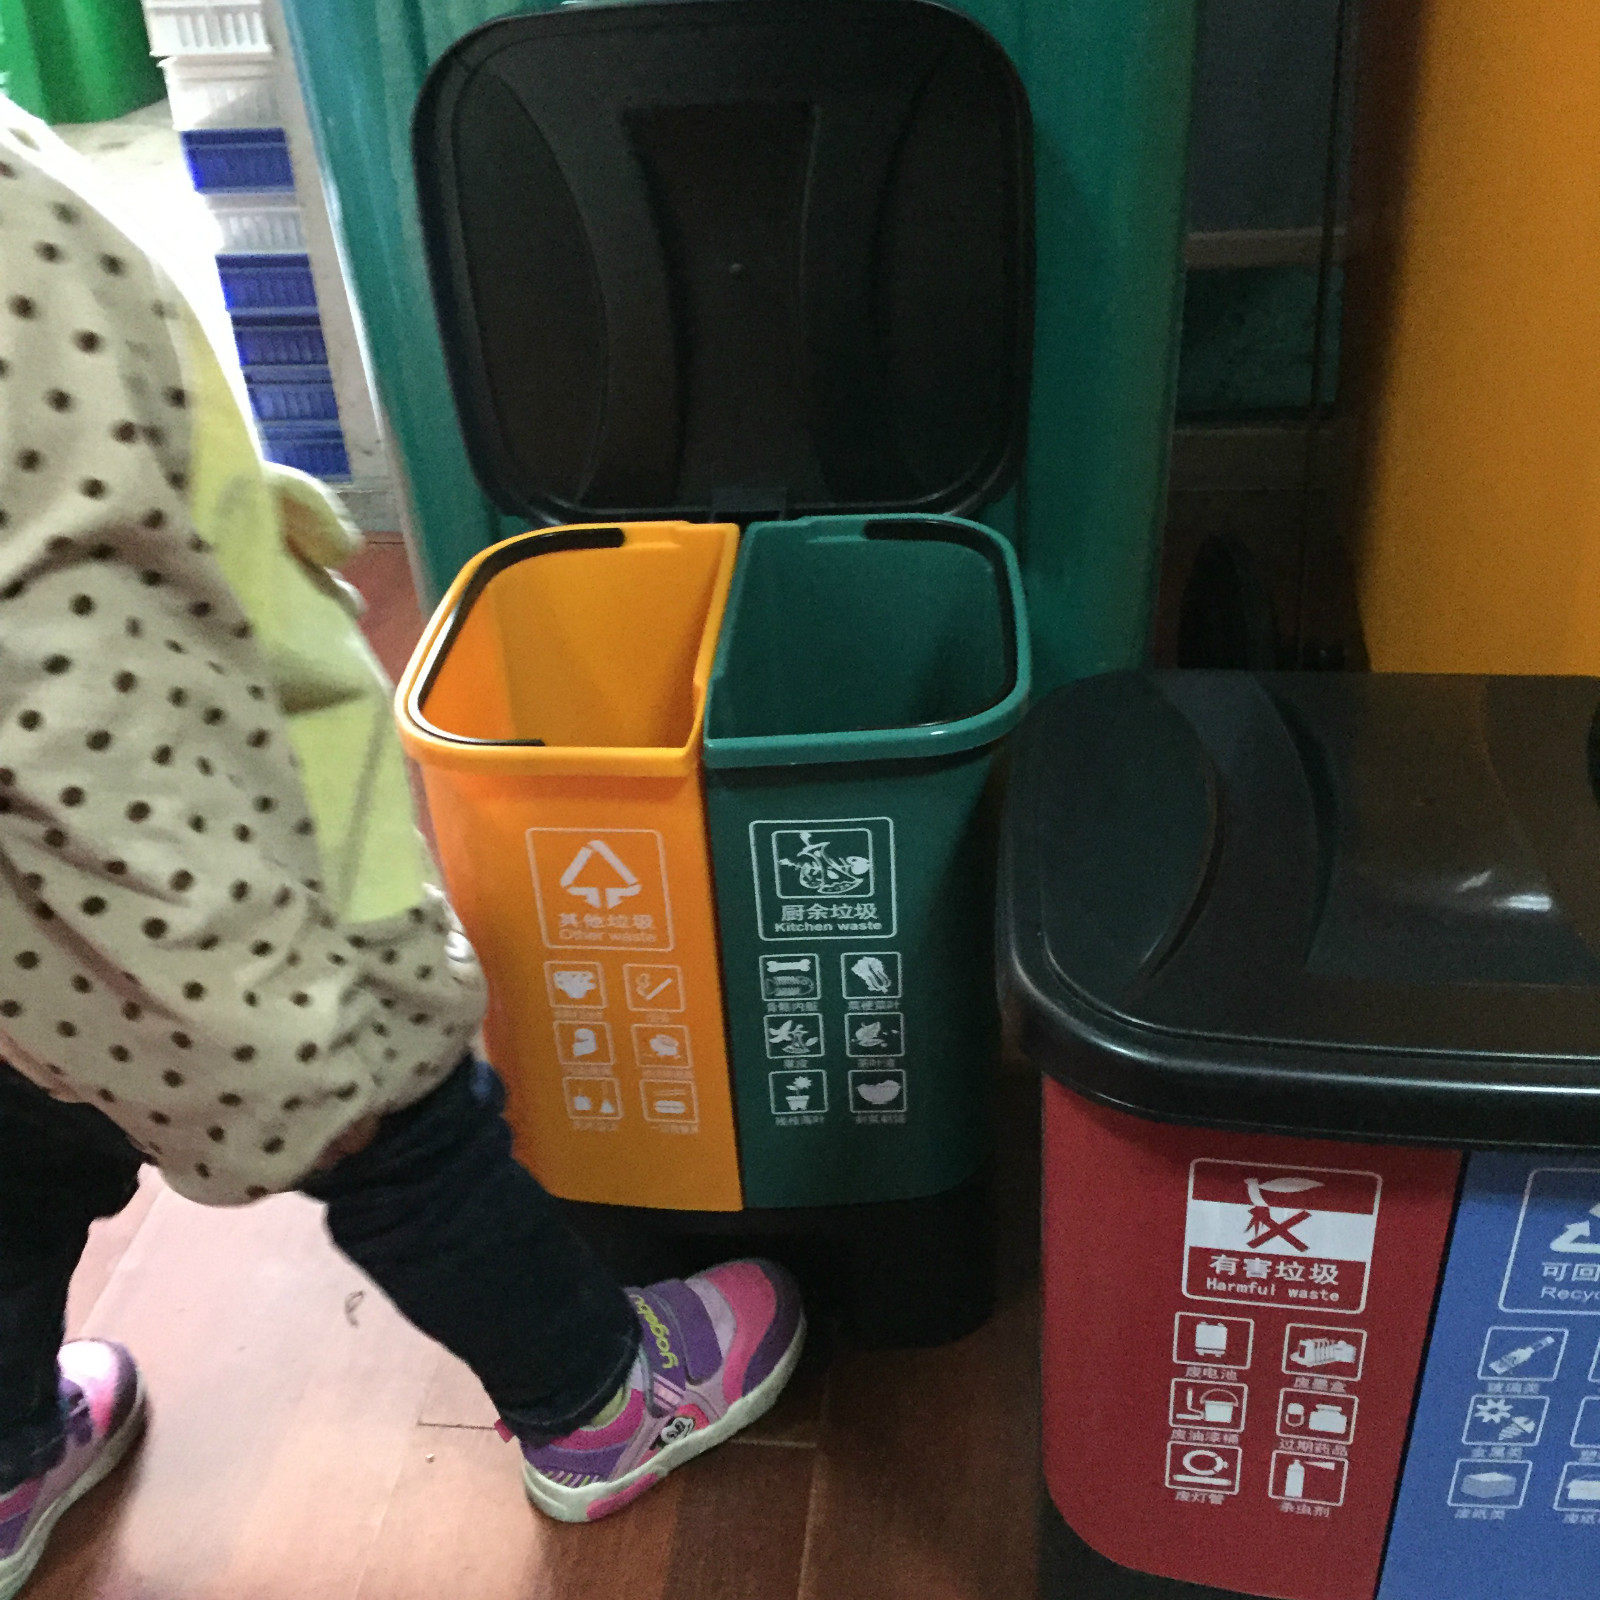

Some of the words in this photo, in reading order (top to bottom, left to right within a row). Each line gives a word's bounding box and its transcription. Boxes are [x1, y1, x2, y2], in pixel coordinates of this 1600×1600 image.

[781, 903, 878, 921] 厨余垃圾
[774, 922, 833, 932] Kitchen
[837, 921, 883, 931] waste
[1209, 1254, 1339, 1286] 有害垃圾
[1206, 1277, 1277, 1296] Harmful
[1288, 1287, 1340, 1302] waste
